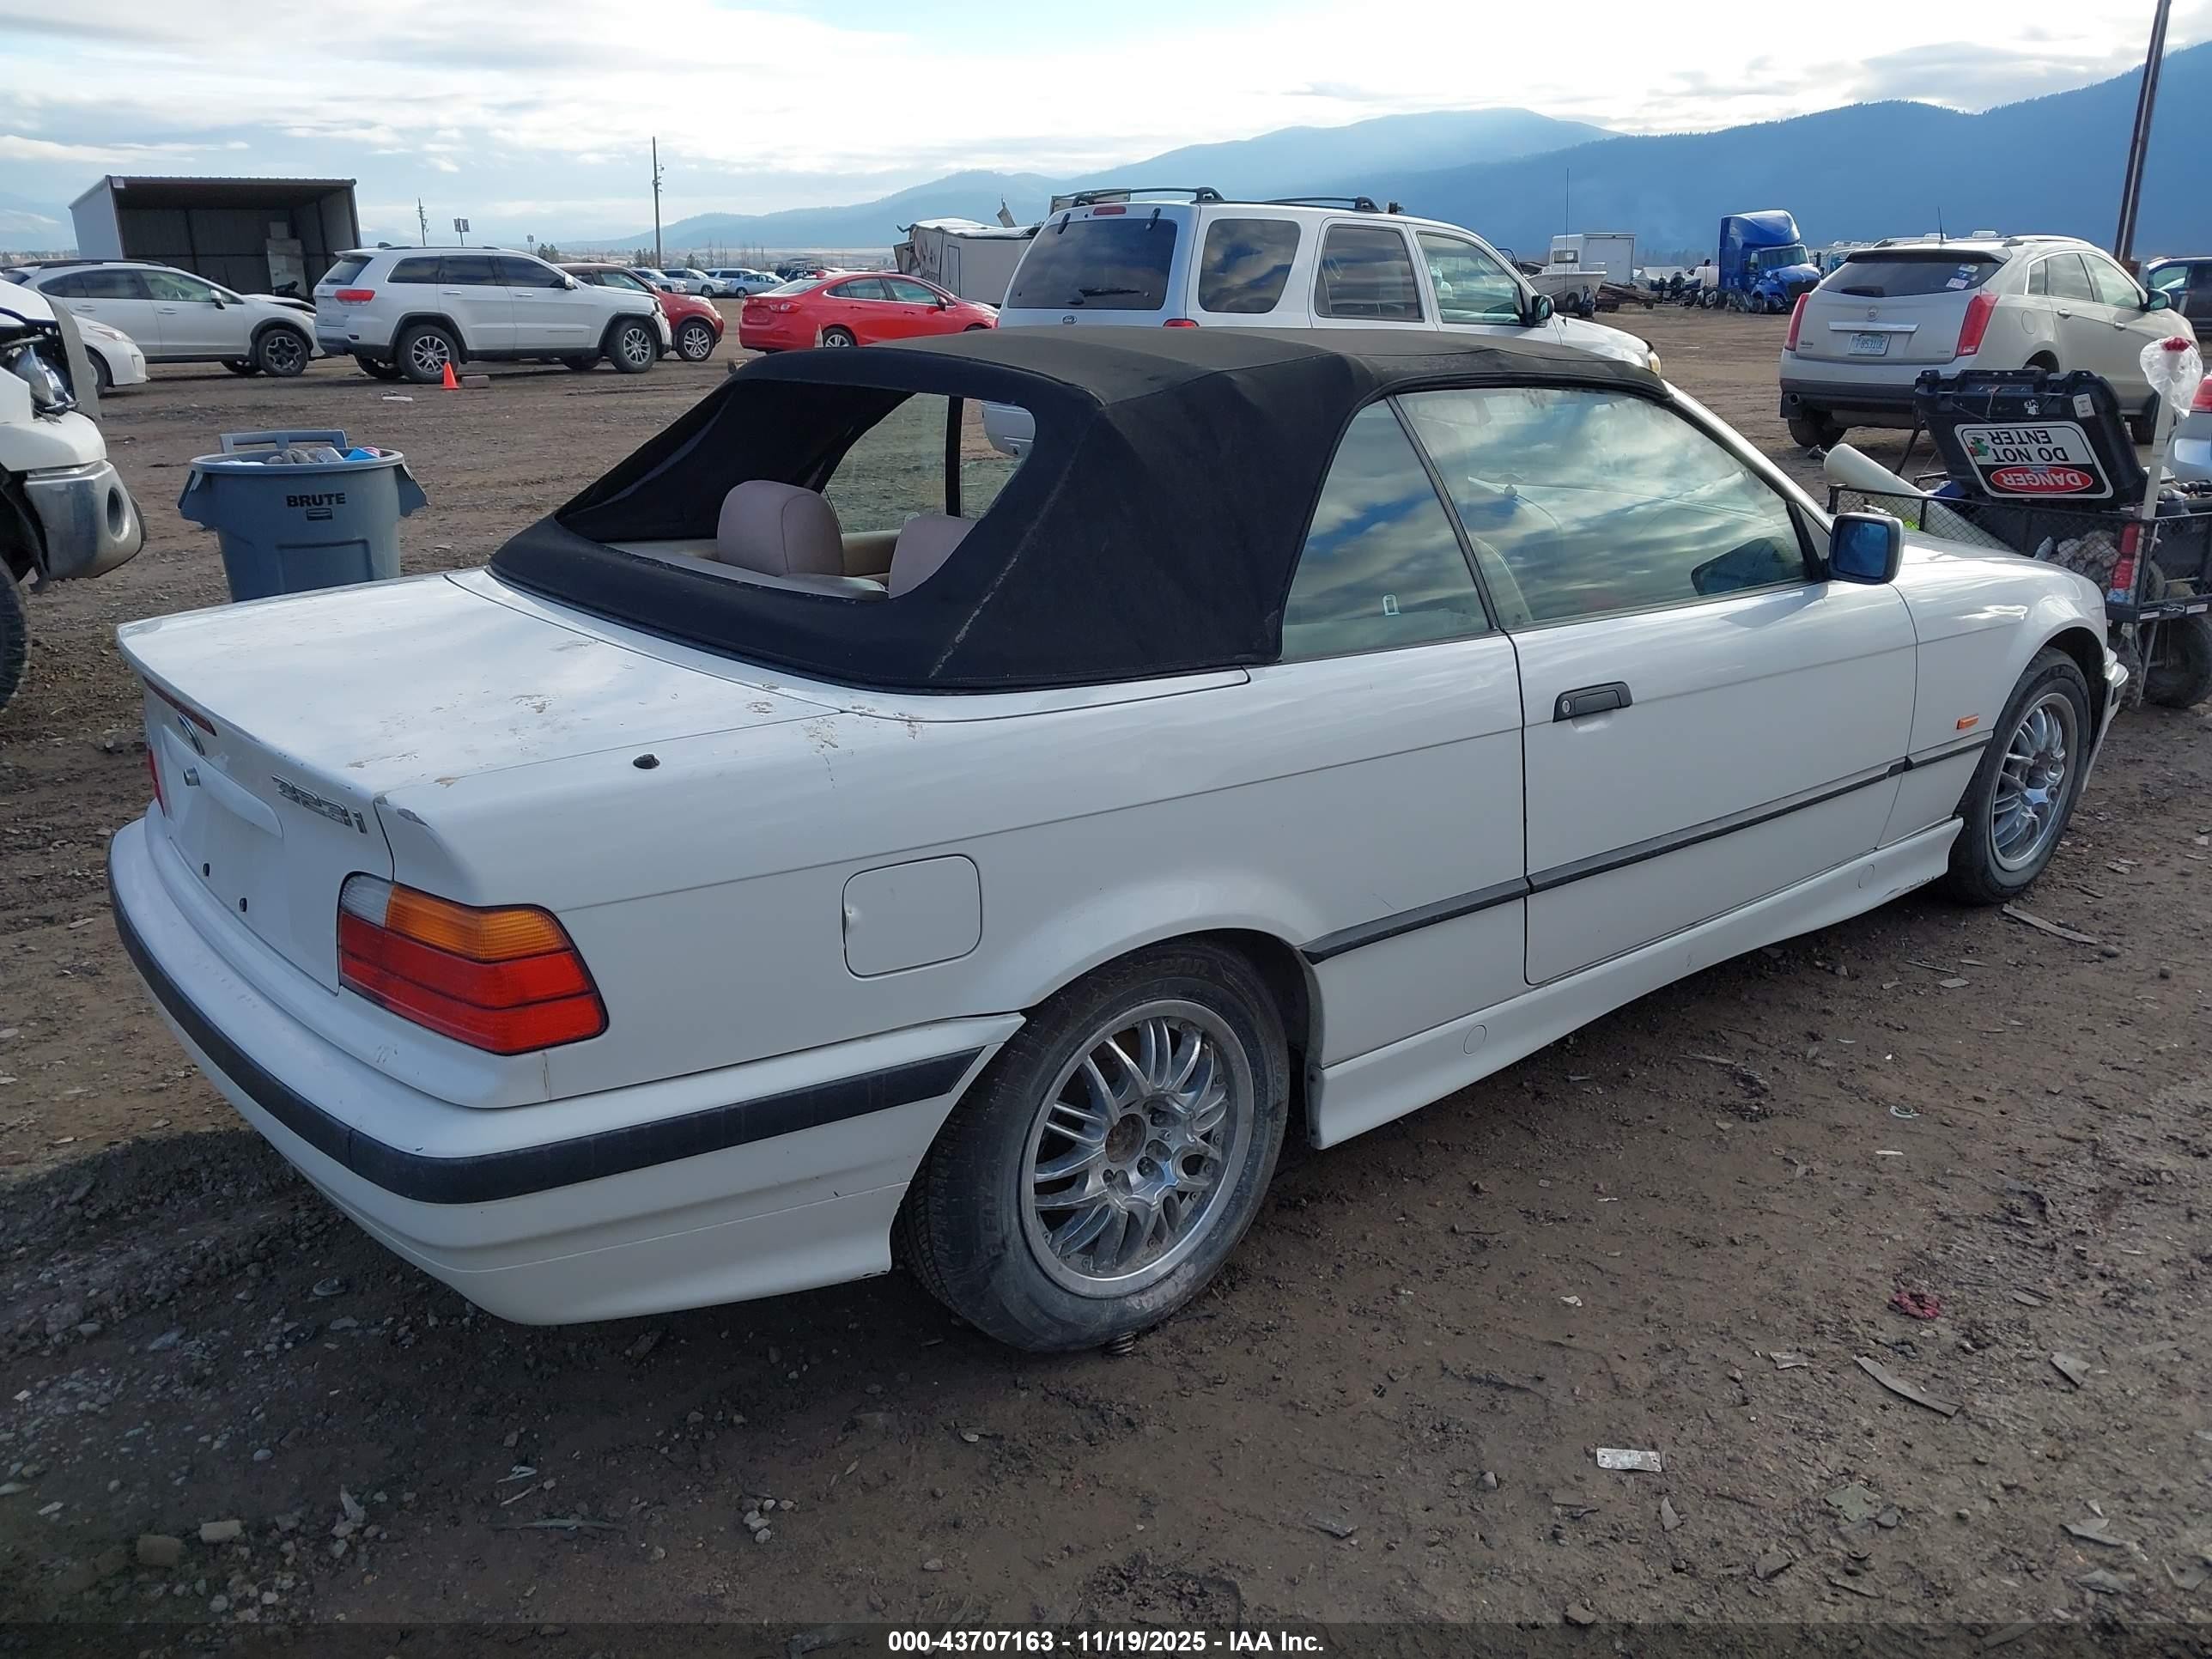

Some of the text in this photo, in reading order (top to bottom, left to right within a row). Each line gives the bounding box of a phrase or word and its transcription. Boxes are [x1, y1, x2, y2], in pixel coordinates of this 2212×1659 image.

[1987, 430, 2053, 445] ENTER
[1992, 447, 2069, 463] DO NOT
[2001, 473, 2082, 486] DANGER
[286, 492, 346, 508] BRUTE
[270, 773, 368, 835] 323i
